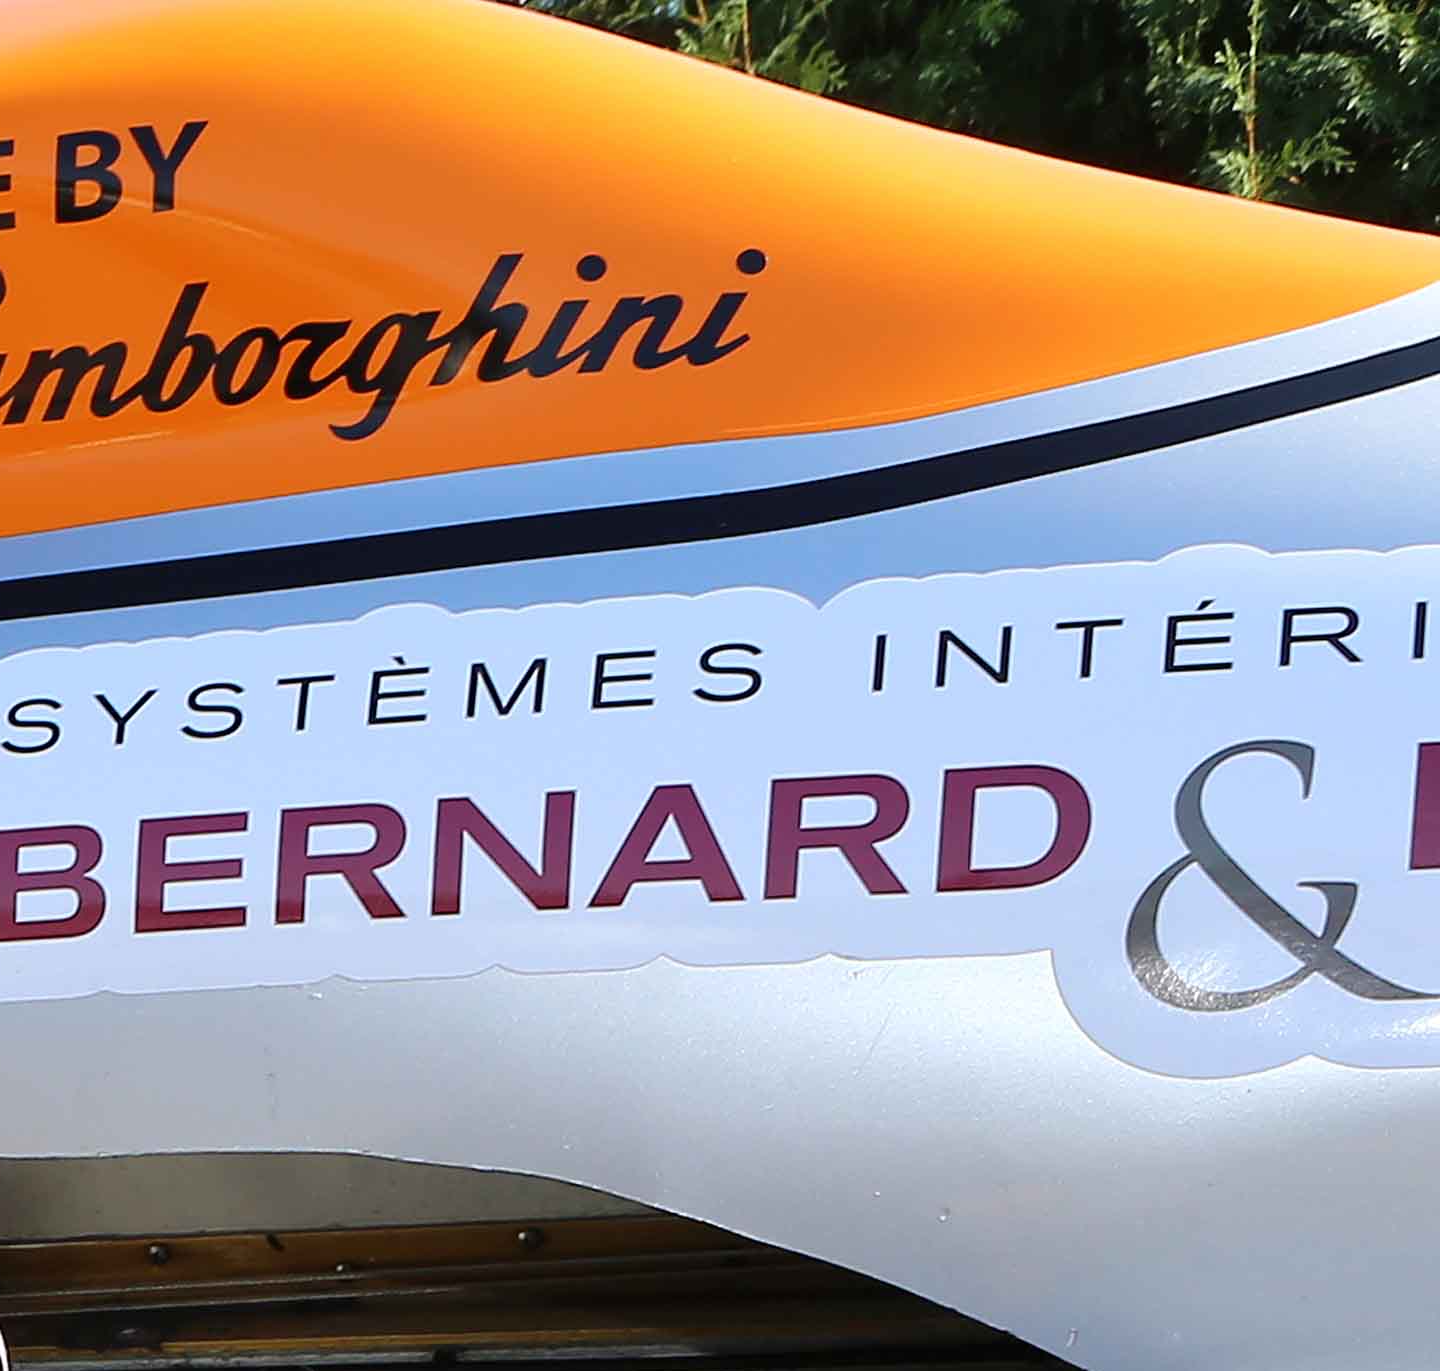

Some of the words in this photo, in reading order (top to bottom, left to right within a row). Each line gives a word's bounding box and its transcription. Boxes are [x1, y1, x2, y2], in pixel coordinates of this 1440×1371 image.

[54, 120, 209, 224] BY
[0, 642, 765, 754] SYSTÈMES
[1126, 738, 1440, 1015] &
